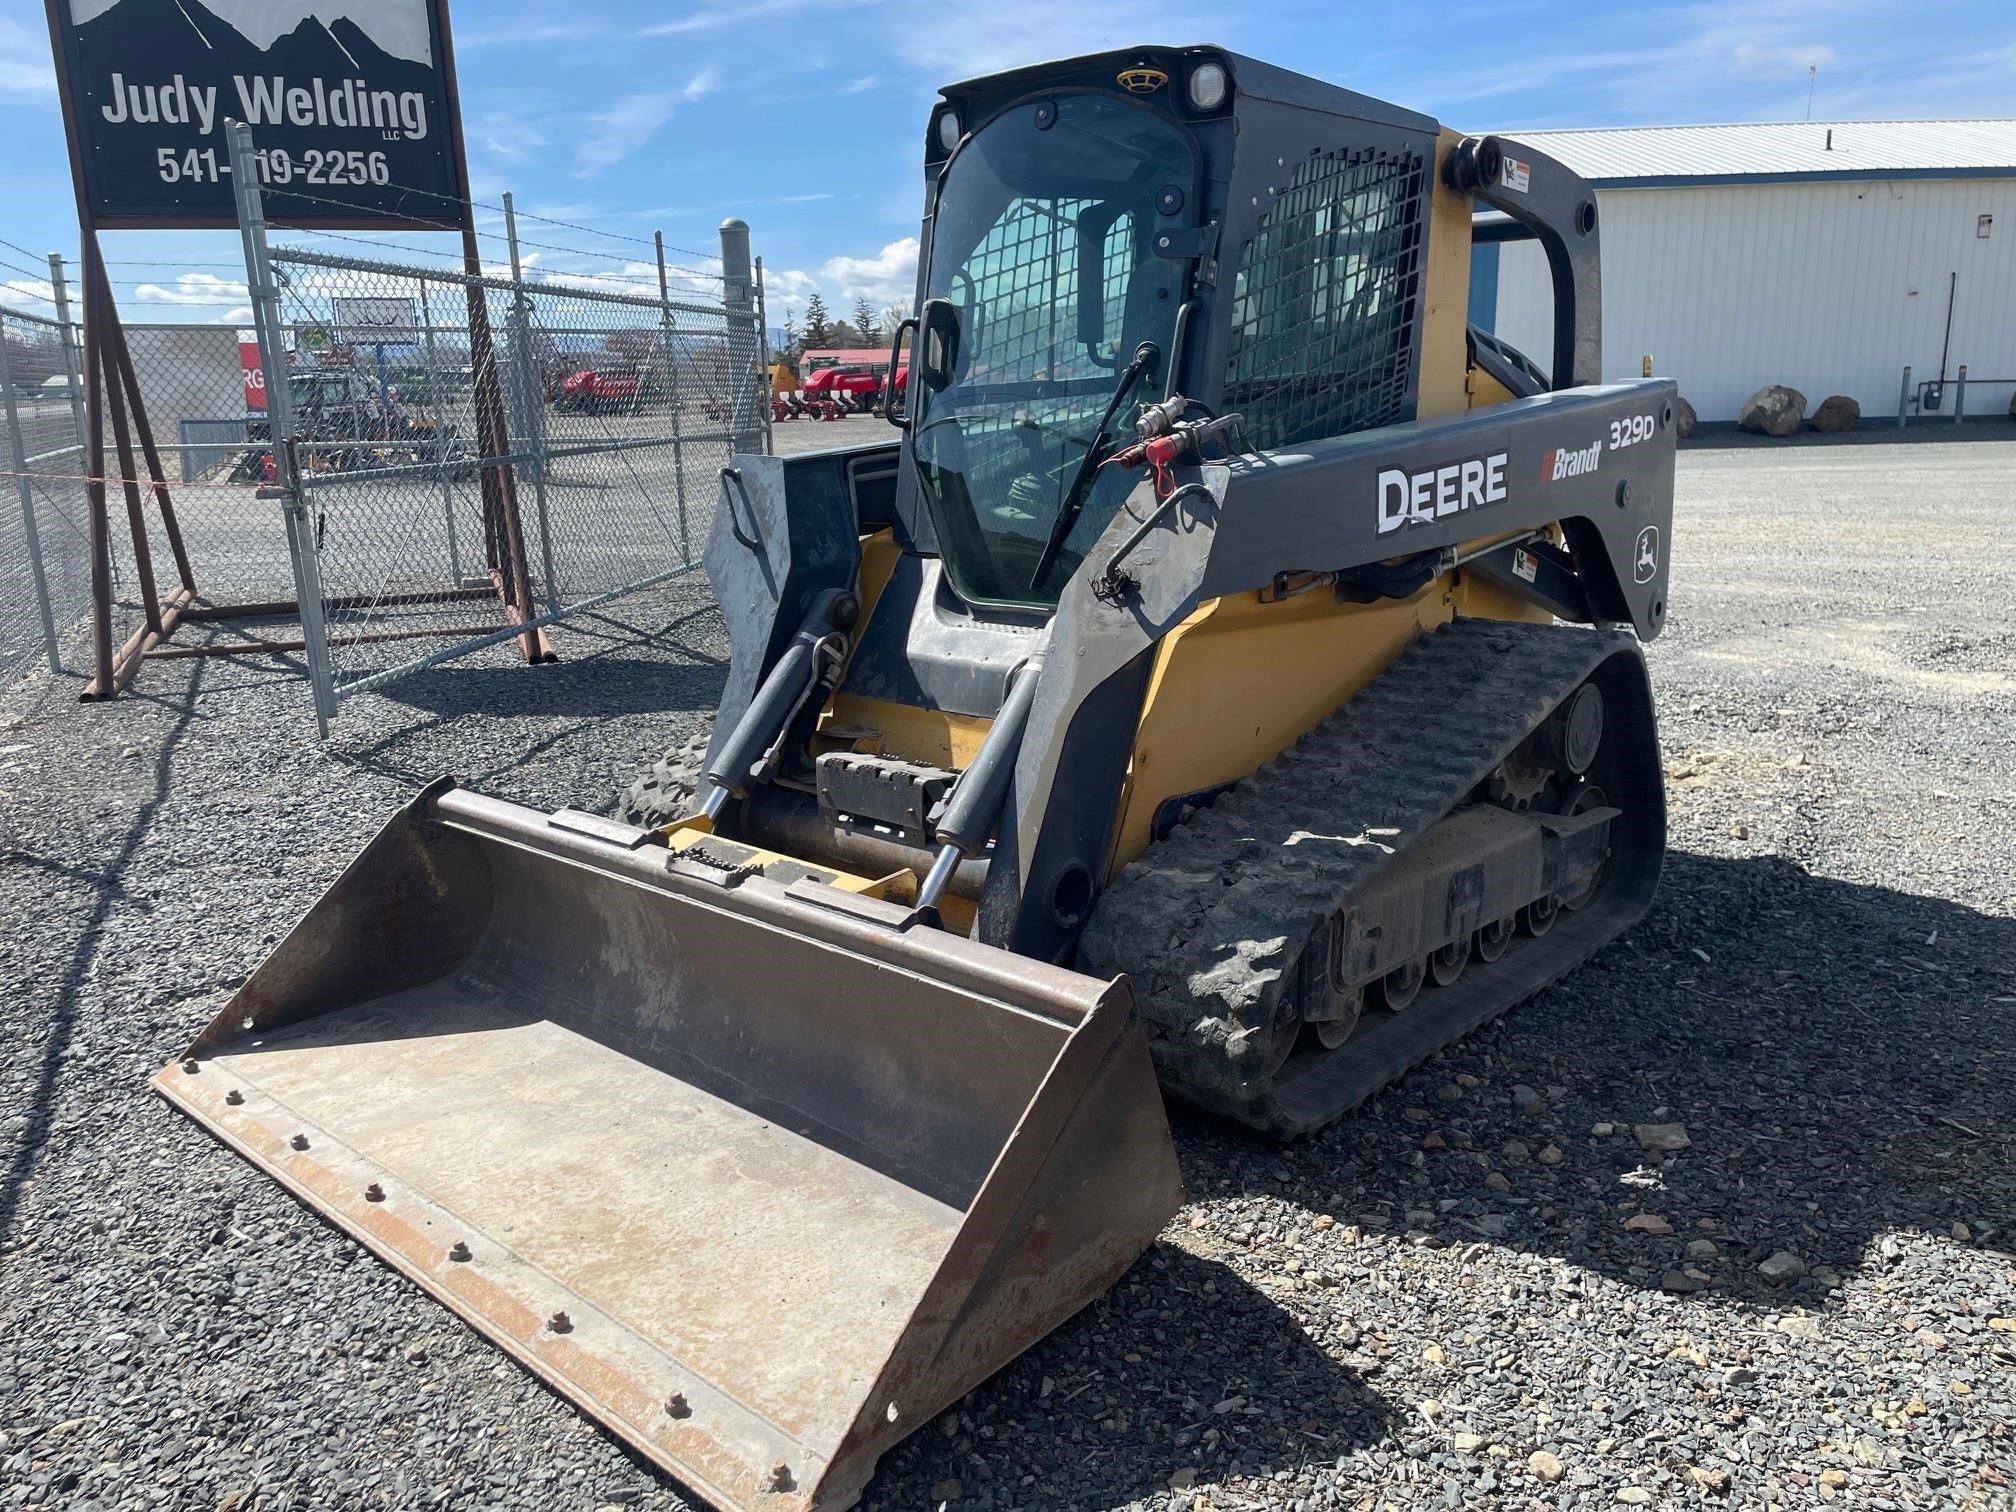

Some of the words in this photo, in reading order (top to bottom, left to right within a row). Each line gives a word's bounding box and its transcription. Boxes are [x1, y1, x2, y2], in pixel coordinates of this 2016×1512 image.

[102, 73, 217, 135] Judy
[233, 75, 428, 140] Welding
[382, 130, 400, 140] LLC
[157, 147, 390, 186] 541-19-2256
[1609, 415, 1655, 450] 329D
[1552, 440, 1602, 481] Brandt
[1377, 453, 1507, 534] DEERE
